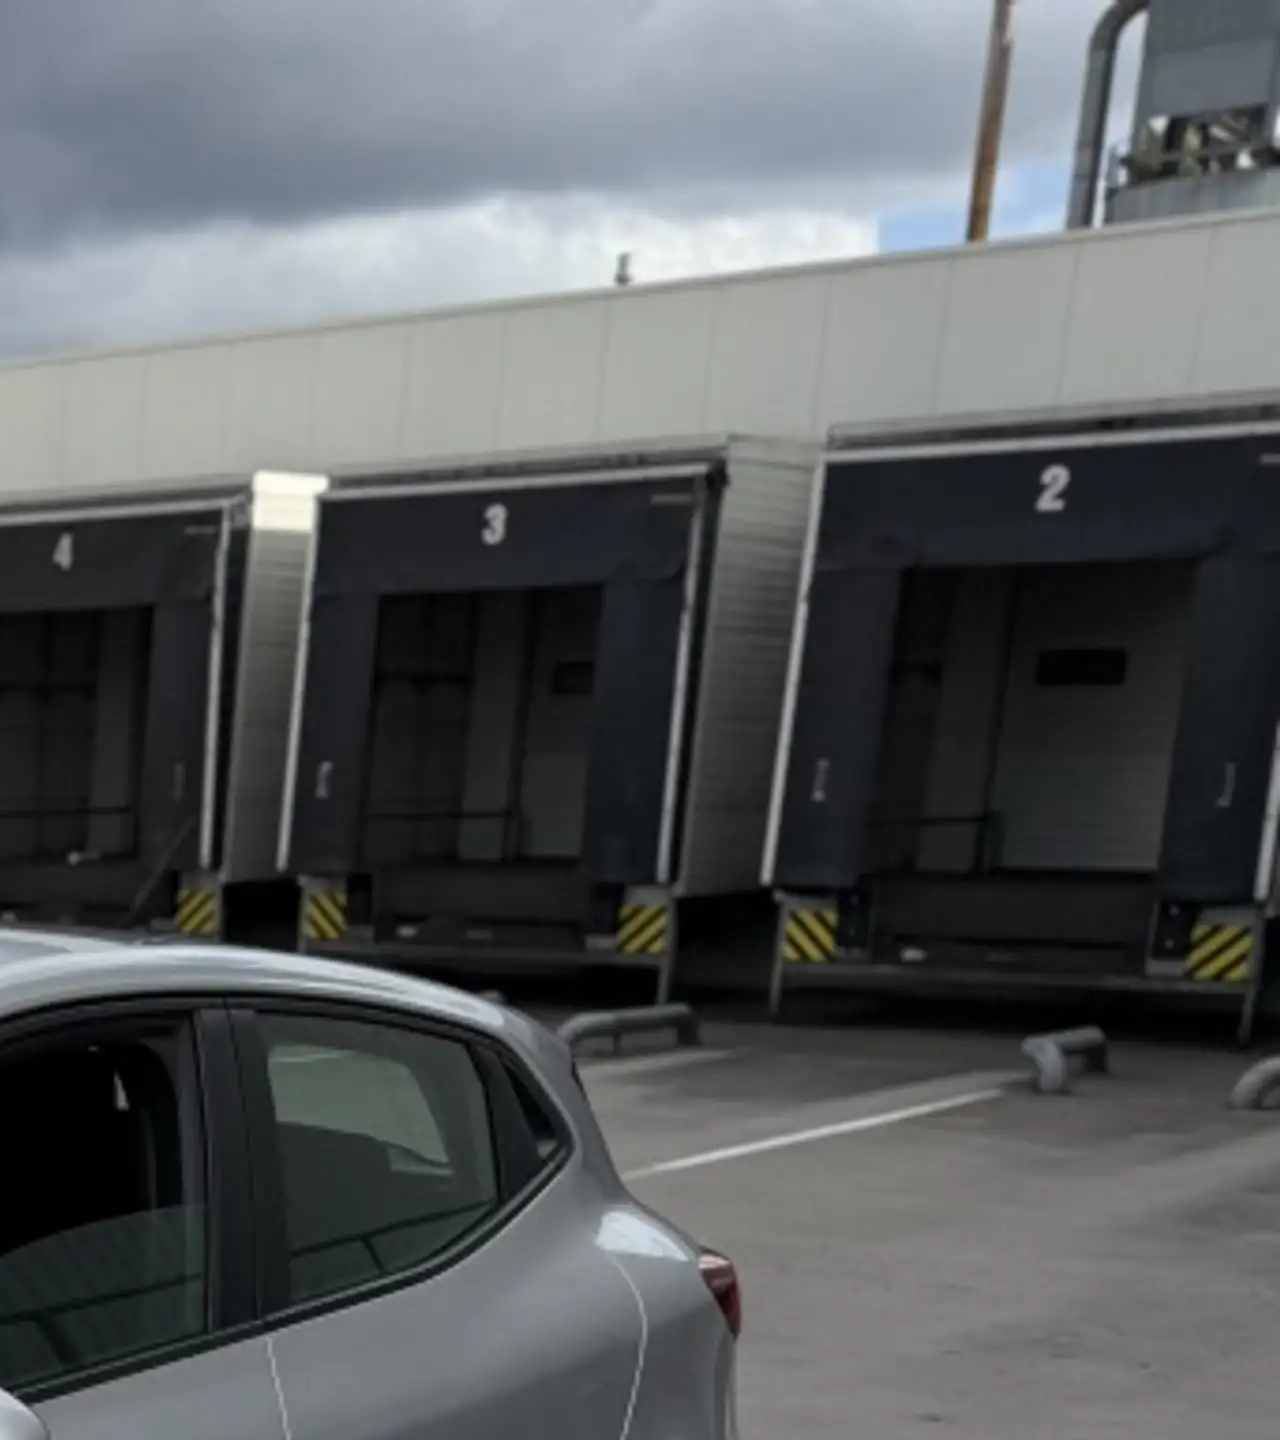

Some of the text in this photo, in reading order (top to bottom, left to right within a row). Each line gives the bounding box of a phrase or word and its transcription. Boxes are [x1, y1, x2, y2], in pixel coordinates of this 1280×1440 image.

[1036, 464, 1071, 512] 2
[482, 504, 508, 545] 3
[53, 533, 73, 570] 4
